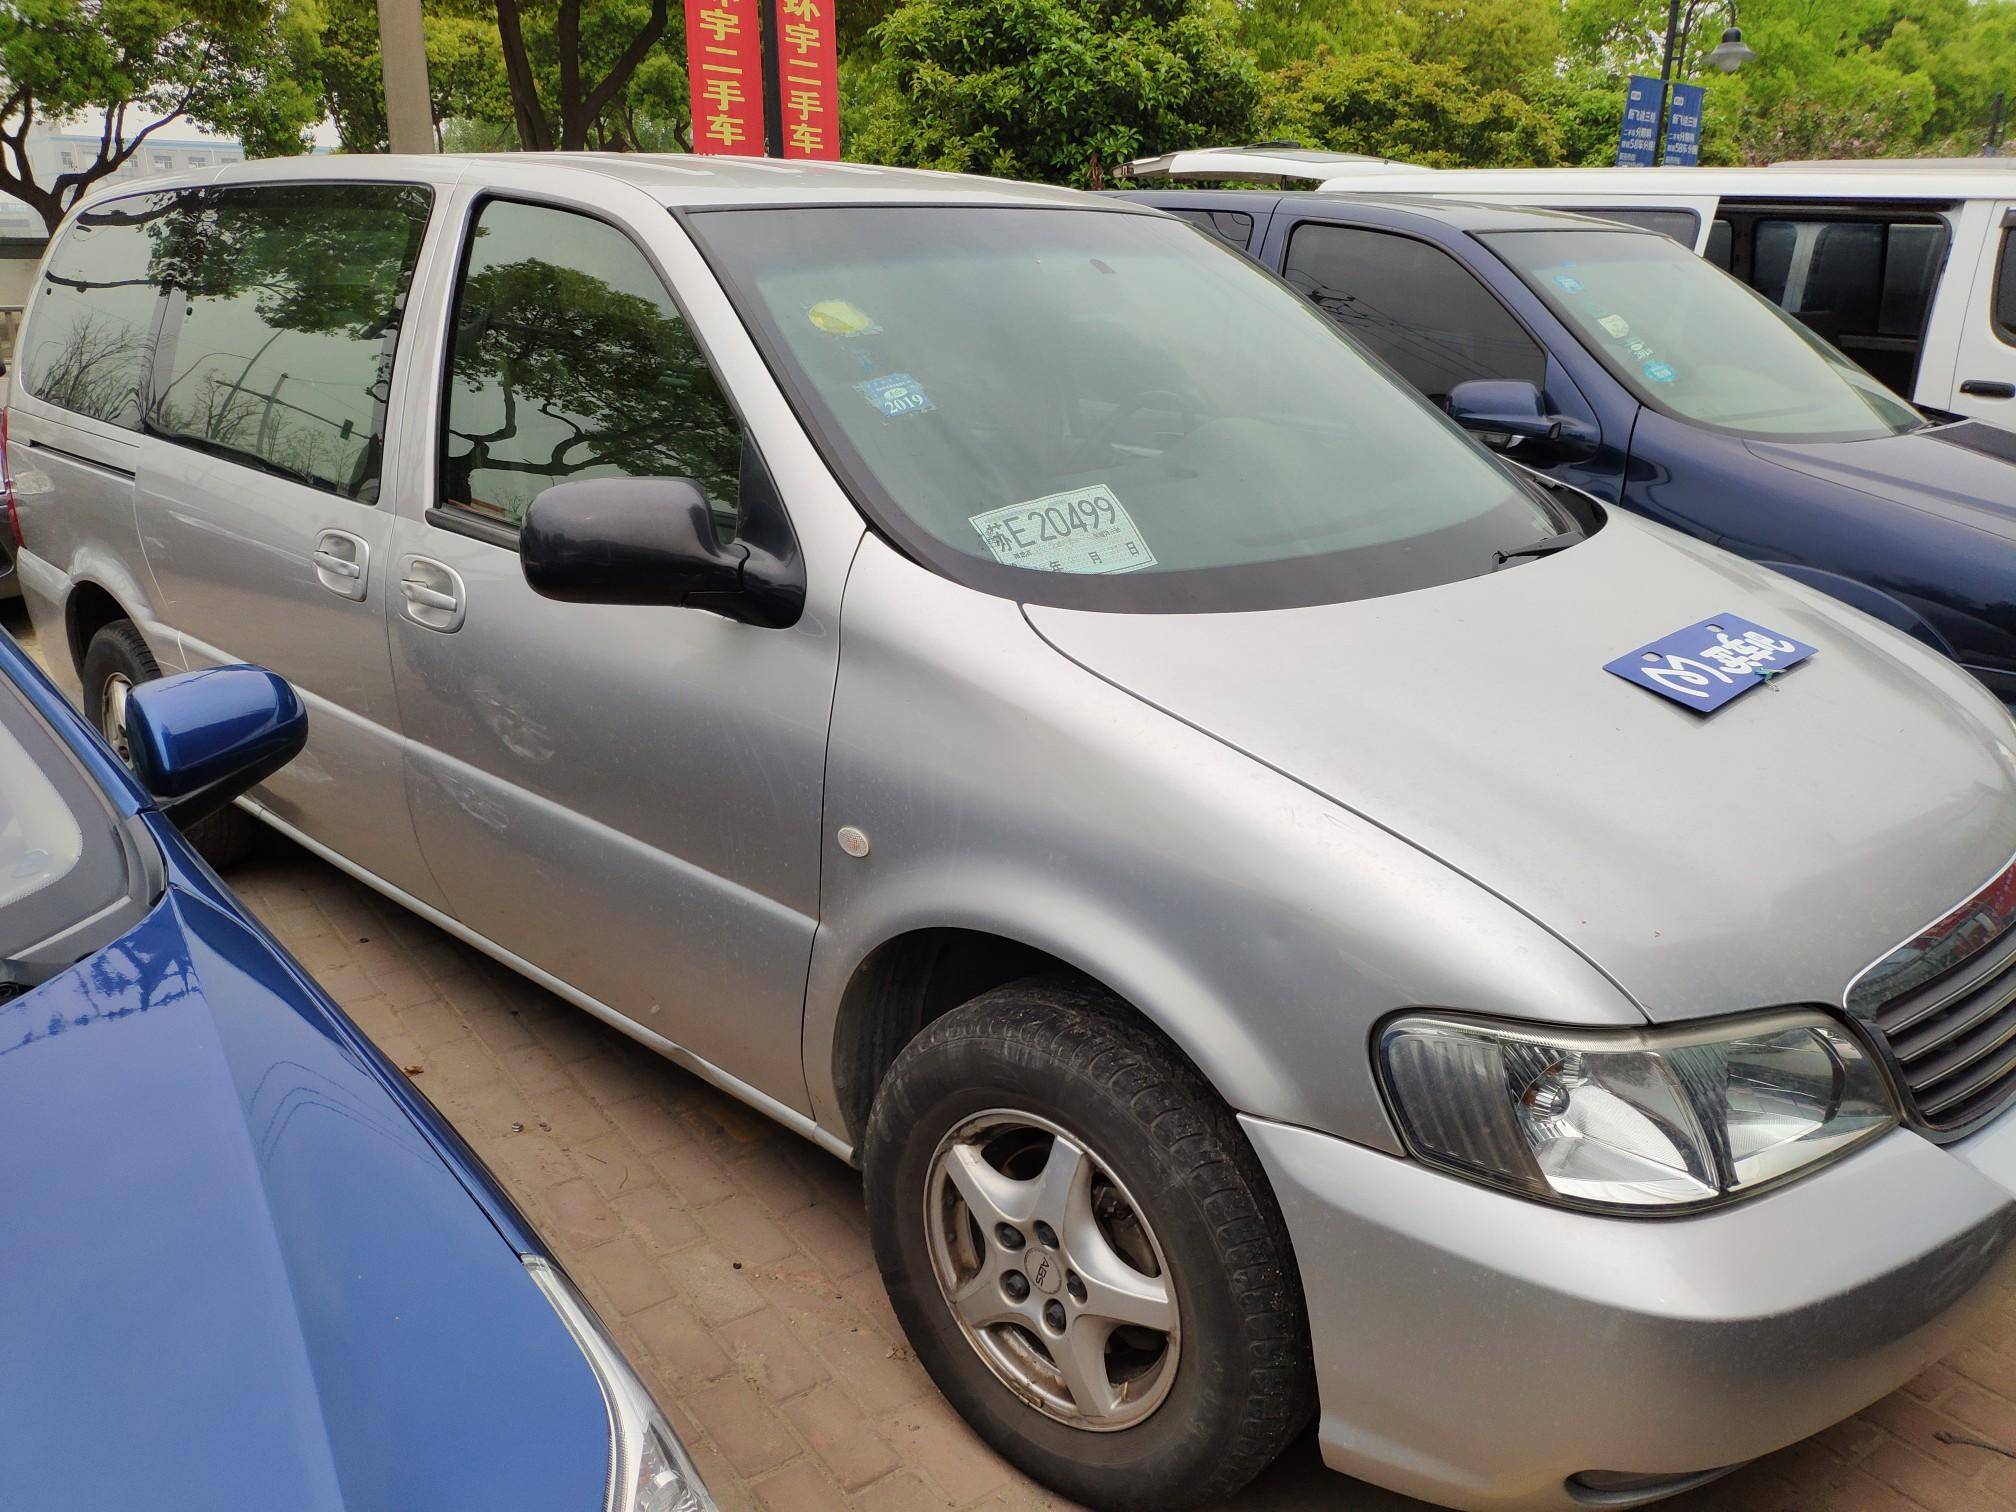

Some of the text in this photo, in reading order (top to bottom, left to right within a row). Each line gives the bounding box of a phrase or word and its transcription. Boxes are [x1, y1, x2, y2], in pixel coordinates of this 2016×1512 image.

[700, 0, 746, 146] 宇二手车
[884, 394, 924, 414] 2019
[986, 496, 1117, 553] 苏E20499
[1088, 551, 1103, 565] 月
[1126, 541, 1139, 556] 日
[1036, 1256, 1050, 1287] ABS
